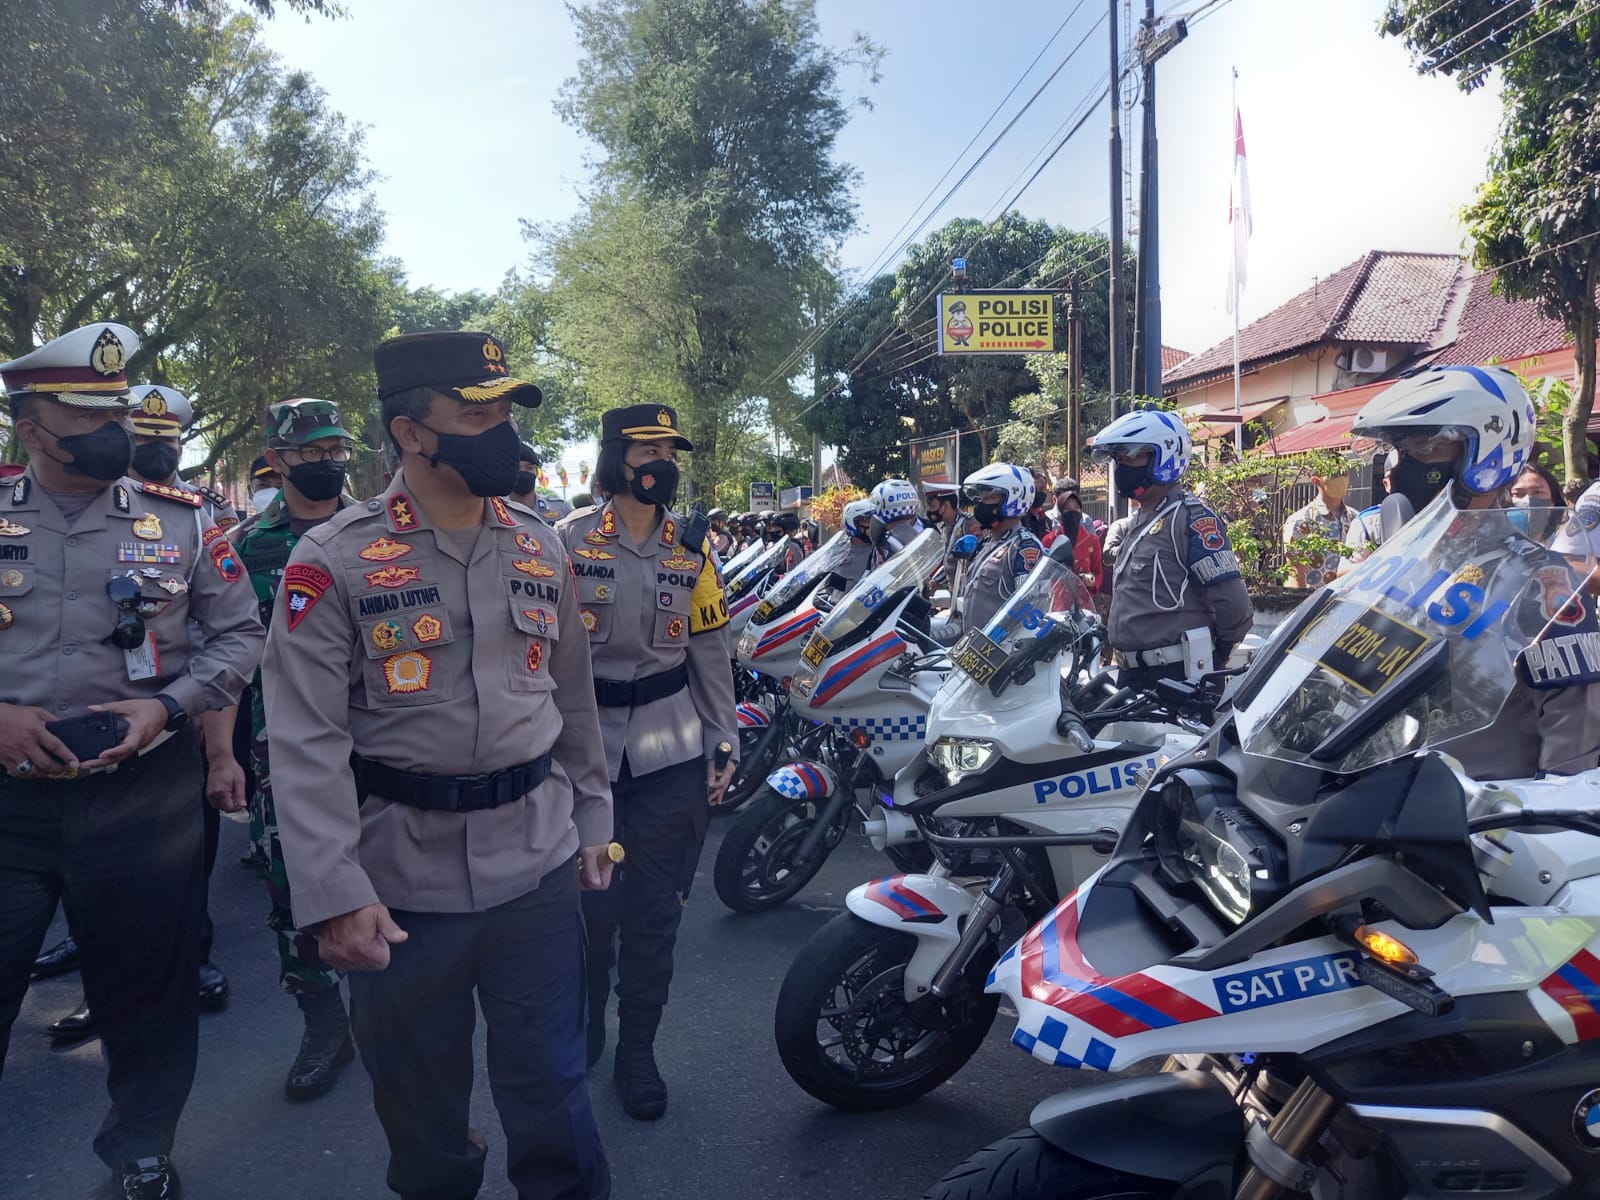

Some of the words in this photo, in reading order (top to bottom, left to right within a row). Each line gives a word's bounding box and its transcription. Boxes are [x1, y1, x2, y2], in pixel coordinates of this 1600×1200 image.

[978, 299, 1048, 315] POLISI
[979, 321, 1049, 337] POLICE
[288, 567, 329, 586] PELOPOR
[359, 593, 399, 616] AHMAD
[400, 586, 441, 608] LUTHFI
[510, 579, 559, 604] POLRI
[701, 604, 718, 627] KA
[980, 642, 995, 656] IX
[1334, 622, 1410, 676] 27201-IX
[1226, 970, 1285, 1006] SAT
[1295, 957, 1360, 993] PJR
